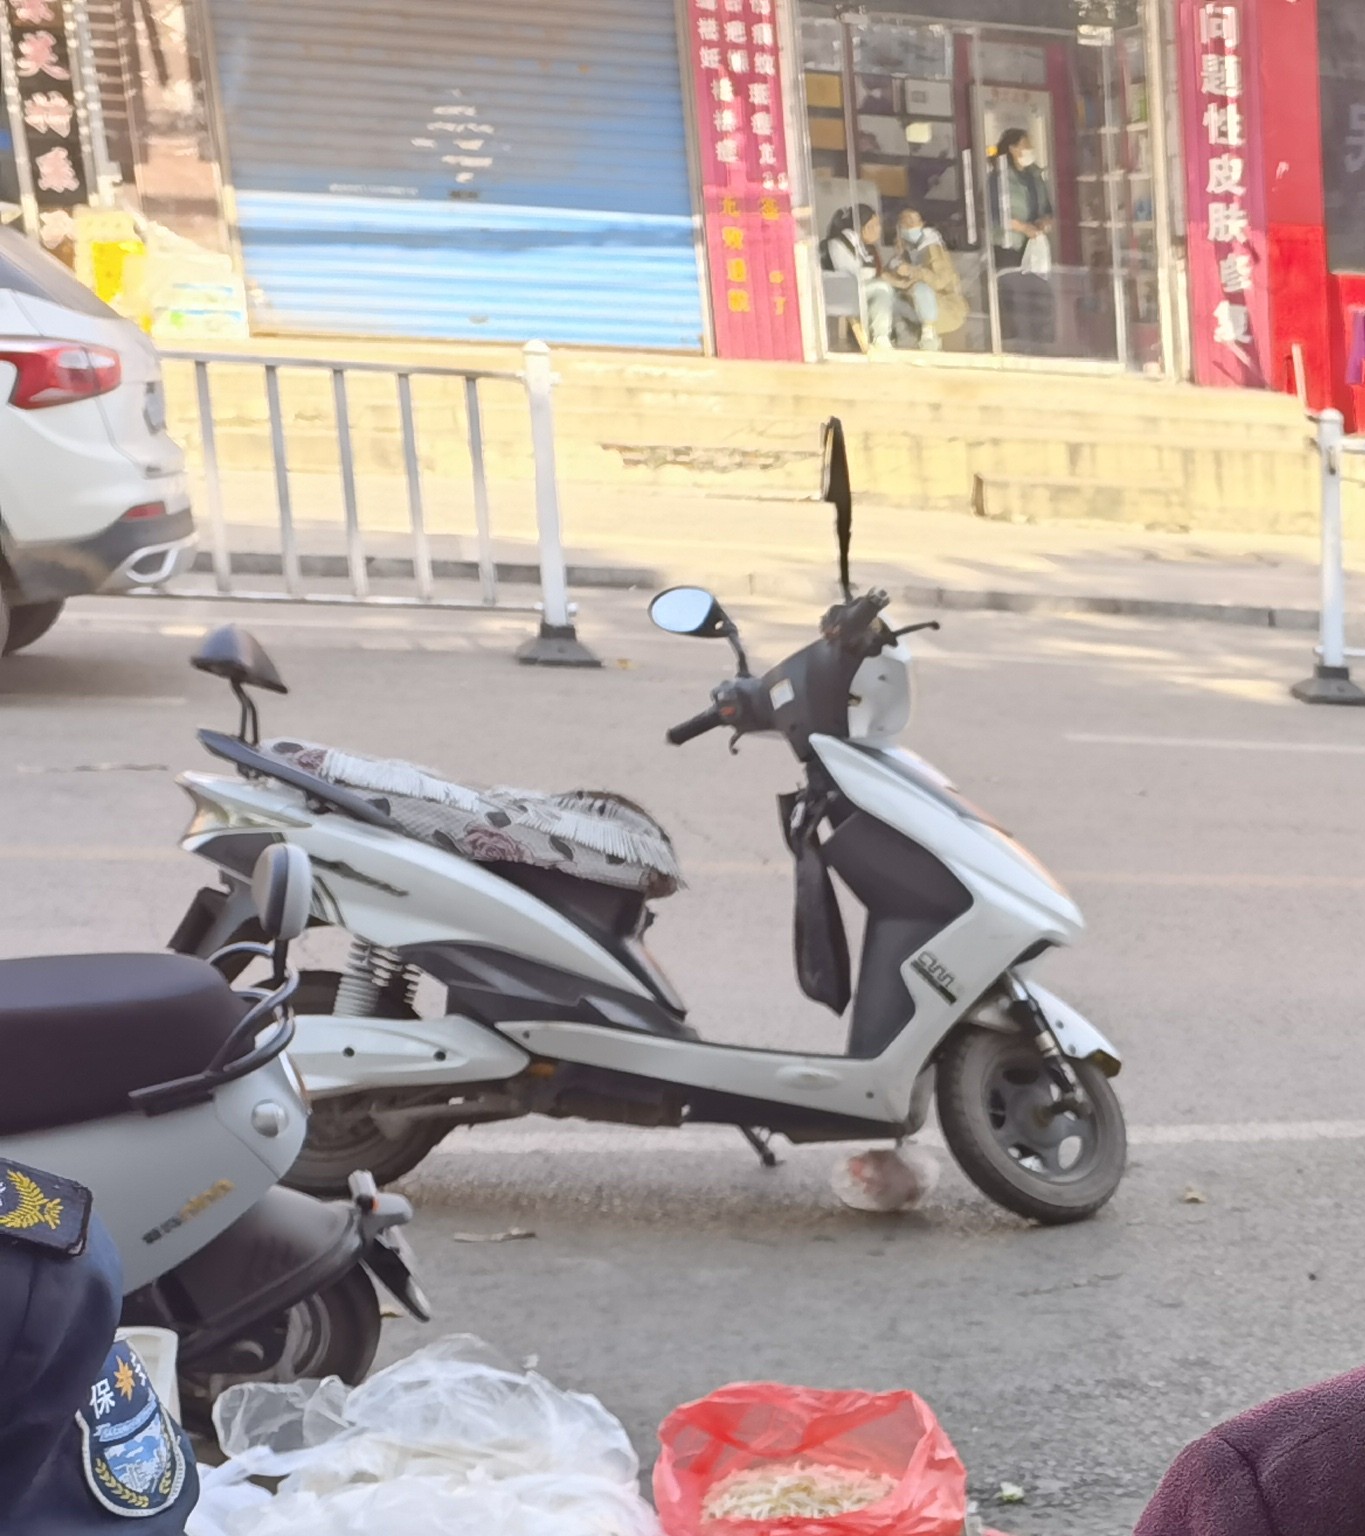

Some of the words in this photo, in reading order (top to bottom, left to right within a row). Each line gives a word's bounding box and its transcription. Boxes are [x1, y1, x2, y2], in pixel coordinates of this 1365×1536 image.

[1199, 5, 1252, 343] 问题性皮肤修复
